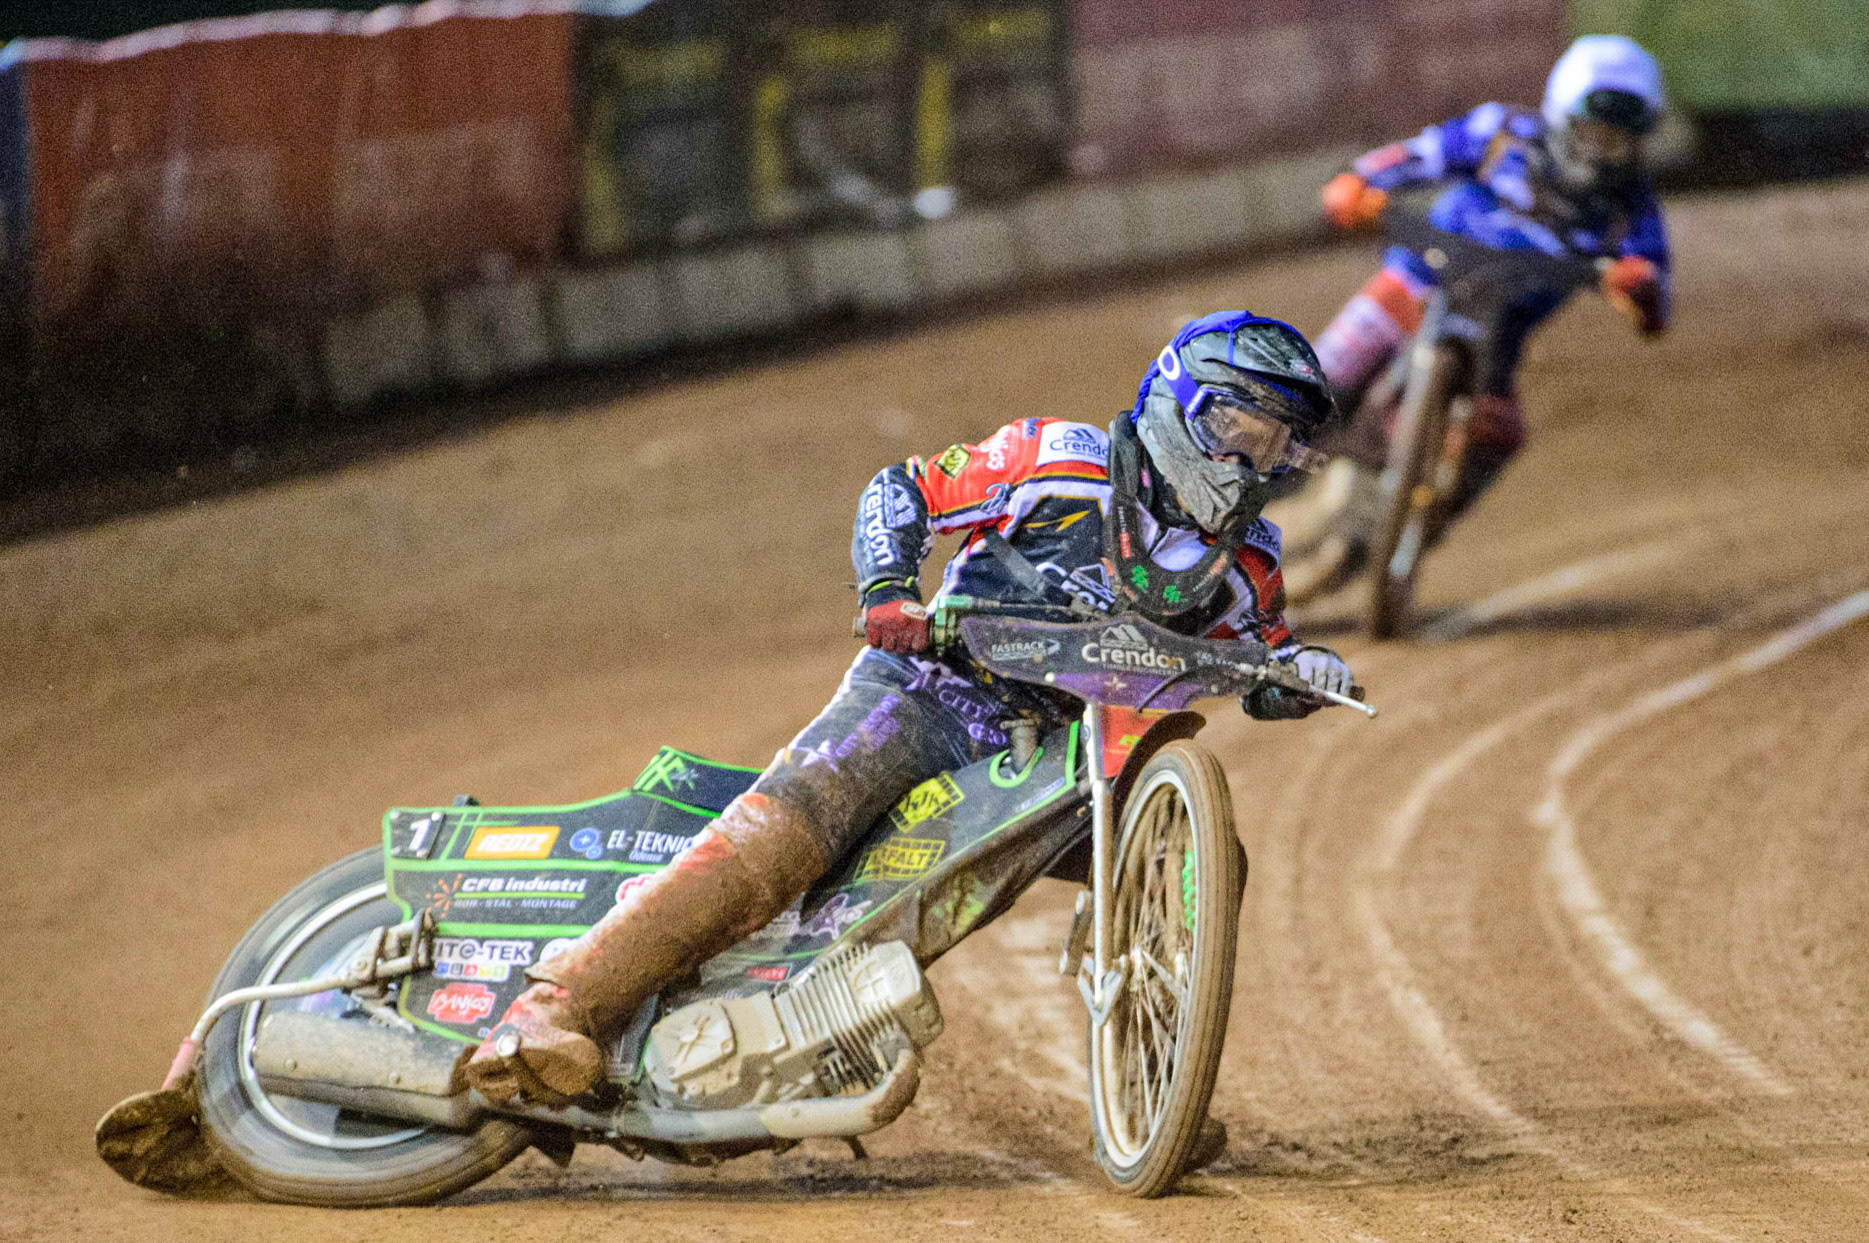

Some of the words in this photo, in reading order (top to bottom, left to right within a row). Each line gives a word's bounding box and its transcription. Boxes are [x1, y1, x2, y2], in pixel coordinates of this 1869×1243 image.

[865, 482, 895, 567] rendon
[991, 640, 1045, 655] FASTRACK
[1081, 642, 1186, 672] Crendon
[409, 818, 432, 851] 1
[521, 898, 578, 909] MONTAGE
